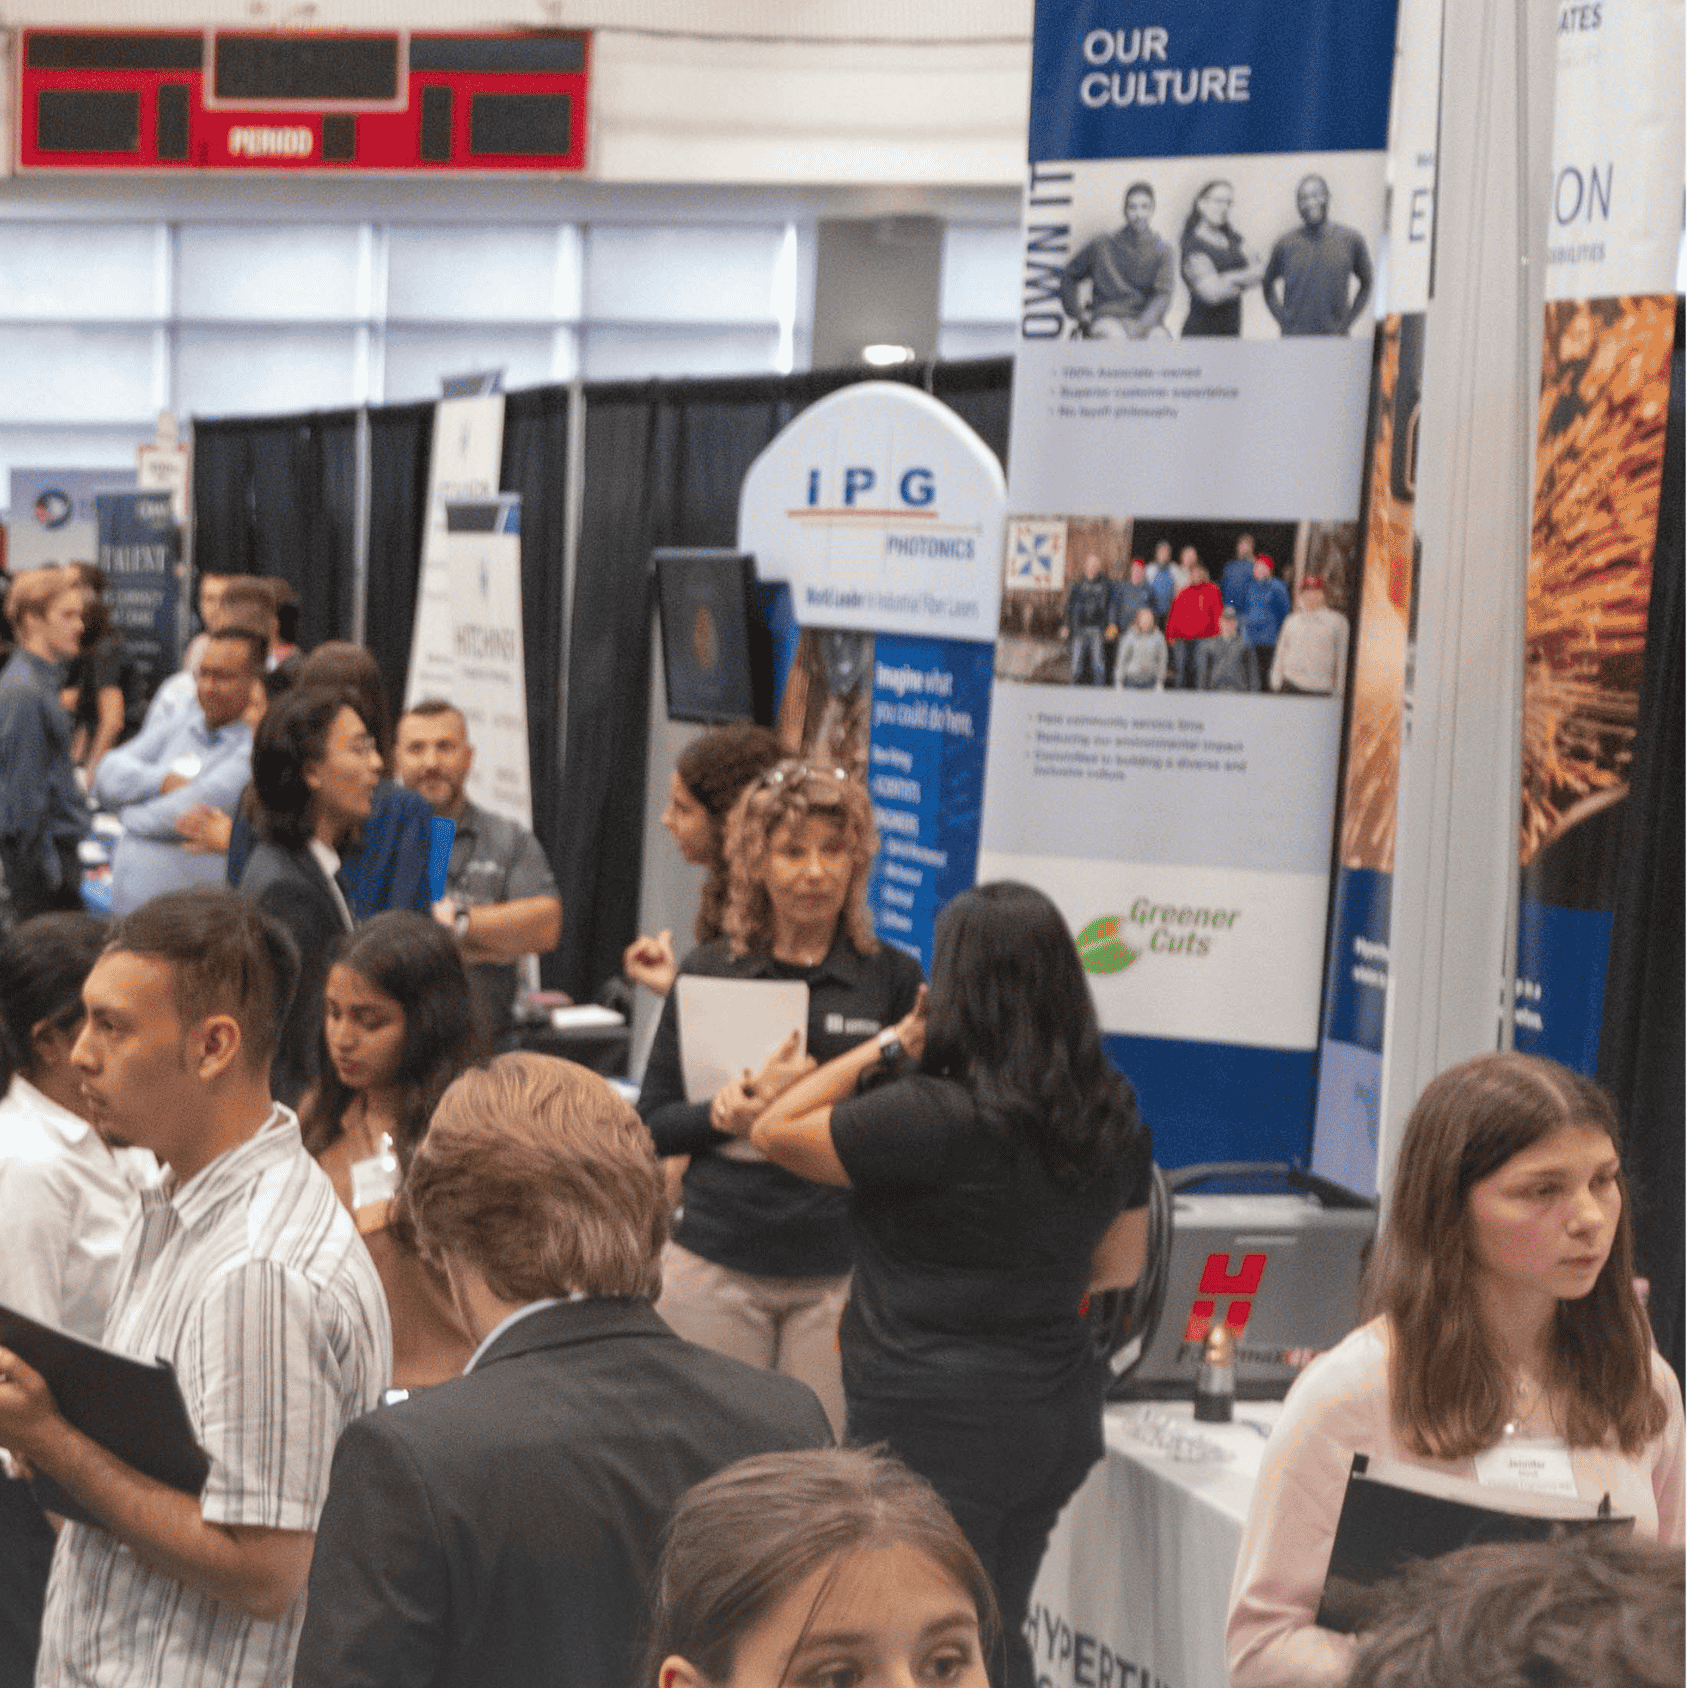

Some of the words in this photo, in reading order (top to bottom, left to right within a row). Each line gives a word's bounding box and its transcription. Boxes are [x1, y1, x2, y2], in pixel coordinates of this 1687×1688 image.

[1558, 2, 1604, 34] ATES
[1083, 26, 1169, 64] OUR
[1080, 65, 1252, 108] CULTURE
[228, 127, 313, 157] PERIOD
[1029, 161, 1075, 207] IT
[1022, 224, 1070, 340] OWN
[886, 534, 975, 560] PHOTONICS
[1130, 895, 1241, 930] Greener
[1150, 927, 1212, 957] Cuts
